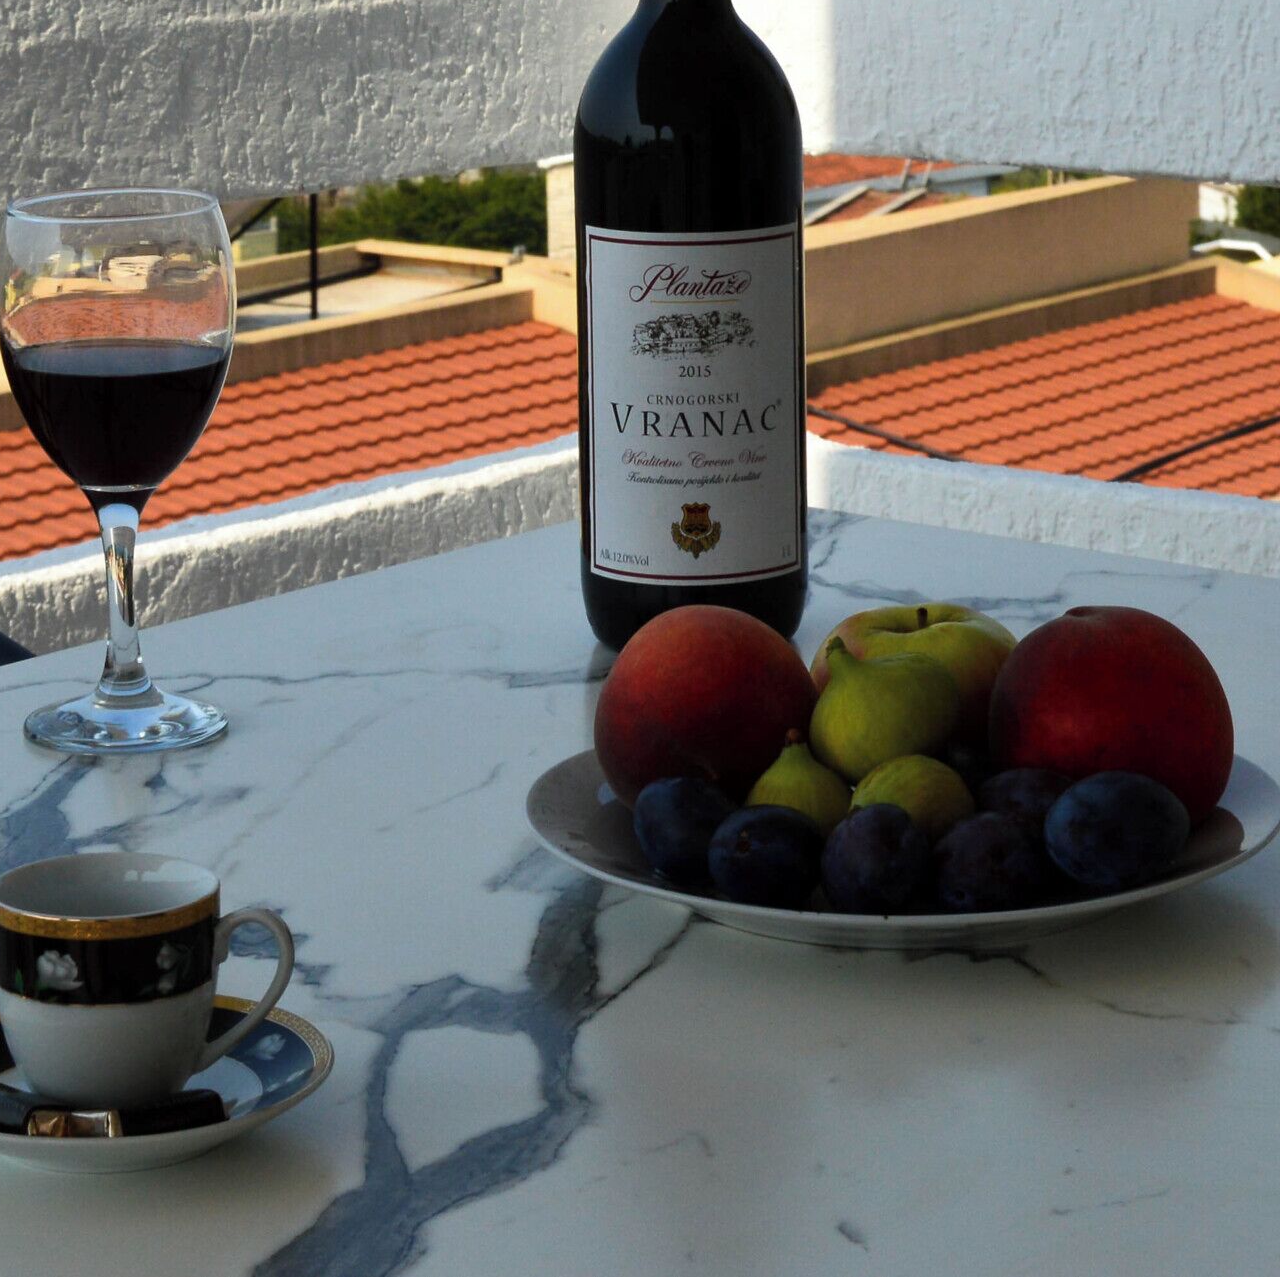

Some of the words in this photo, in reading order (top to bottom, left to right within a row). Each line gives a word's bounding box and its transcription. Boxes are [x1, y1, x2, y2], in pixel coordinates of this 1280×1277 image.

[629, 263, 752, 303] Plantaže
[679, 365, 712, 378] 2015
[646, 392, 740, 406] CRNOGORSKI
[610, 402, 777, 438] VRANAC
[622, 448, 683, 468] Kvalitetno
